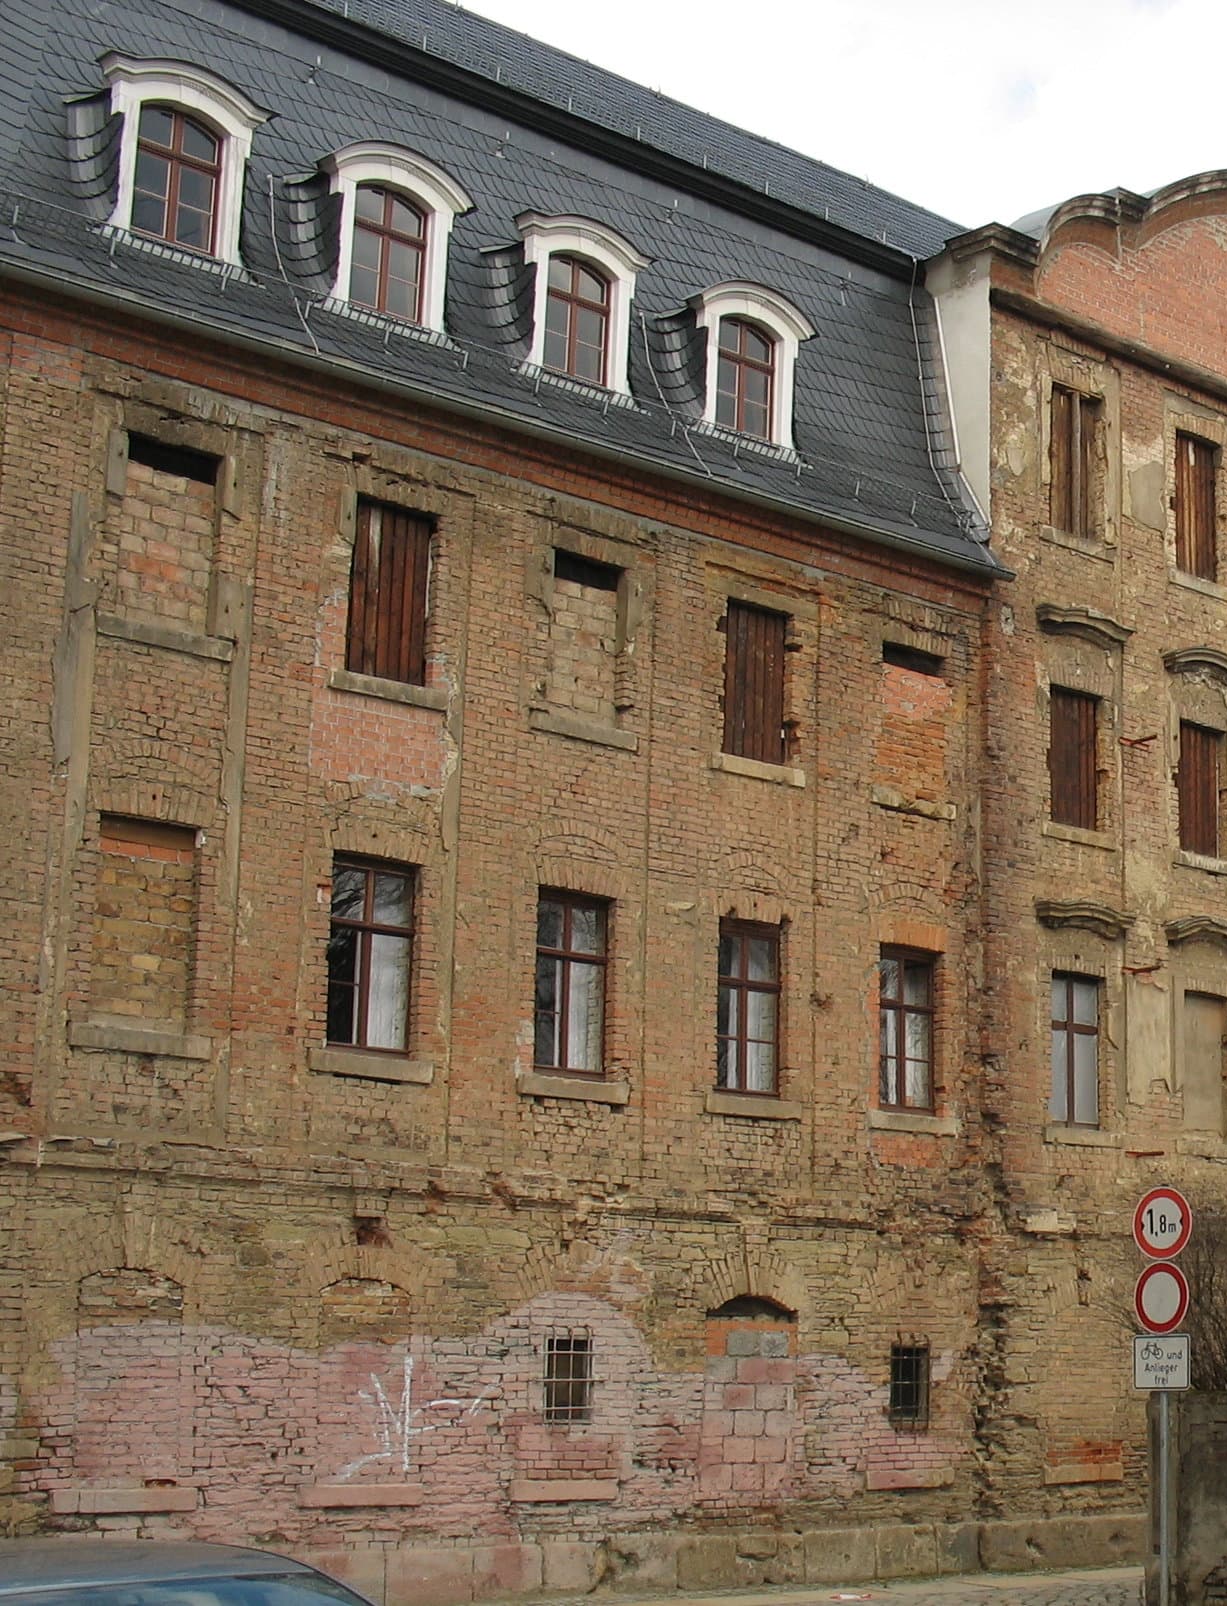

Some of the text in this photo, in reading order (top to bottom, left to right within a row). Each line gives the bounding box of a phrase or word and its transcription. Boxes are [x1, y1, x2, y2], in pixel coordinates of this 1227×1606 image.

[1167, 1350, 1183, 1360] und
[1144, 1363, 1178, 1374] Anlieger
[1154, 1375, 1169, 1385] frei
